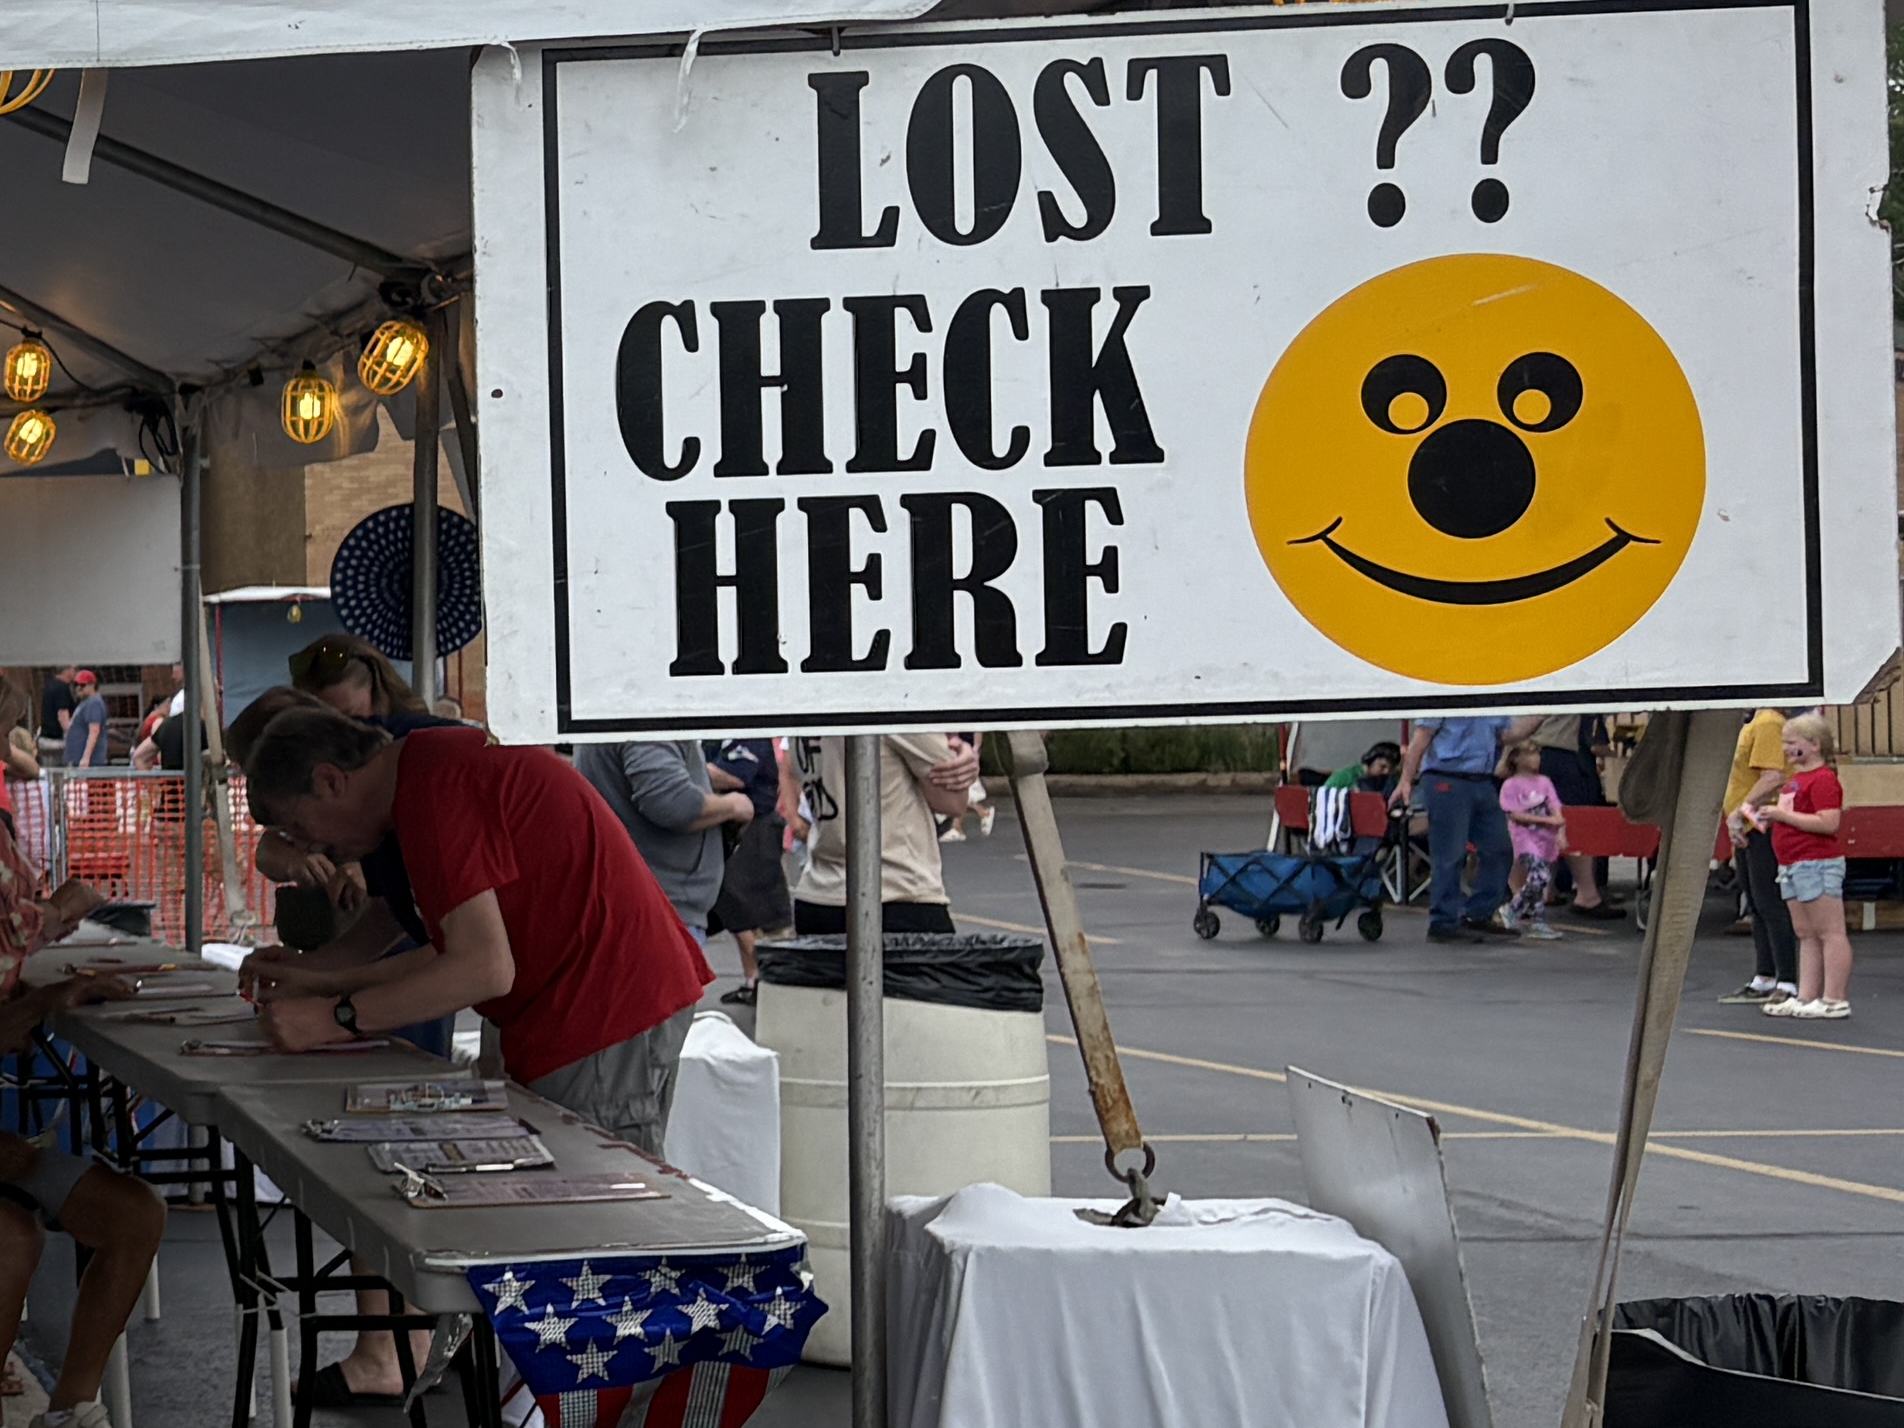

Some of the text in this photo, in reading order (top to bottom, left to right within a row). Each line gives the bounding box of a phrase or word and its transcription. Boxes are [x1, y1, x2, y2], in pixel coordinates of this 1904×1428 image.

[807, 36, 1538, 251] LOST ??
[615, 284, 1166, 483] CHECK
[664, 486, 1130, 678] HERE
